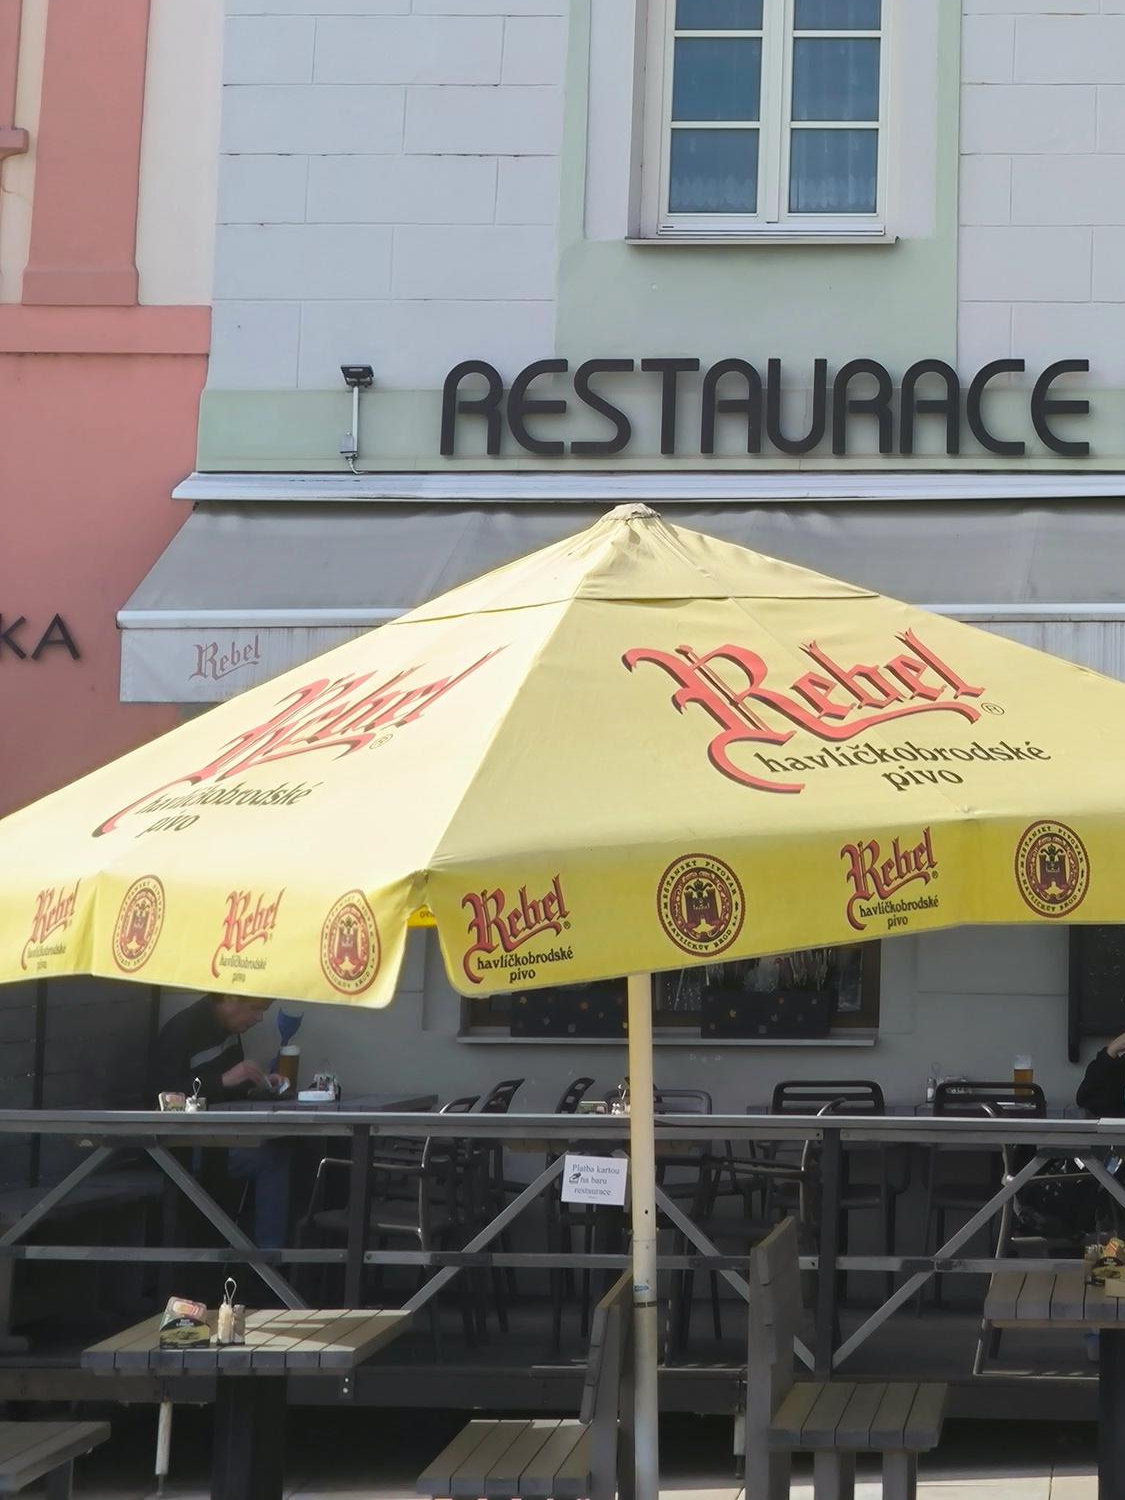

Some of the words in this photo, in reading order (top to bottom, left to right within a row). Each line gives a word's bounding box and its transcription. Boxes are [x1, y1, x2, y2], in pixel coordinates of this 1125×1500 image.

[440, 357, 1090, 456] RESTAURACE
[187, 634, 261, 681] Rebel
[621, 627, 986, 794] Rebel
[753, 739, 1052, 774] havlíčkobrodské
[882, 764, 964, 791] pivo
[840, 826, 939, 931] Rebel
[462, 873, 571, 984] Rebel
[887, 914, 909, 930] pivo
[476, 946, 574, 970] havlíčkobrodské
[509, 967, 536, 983] pivo
